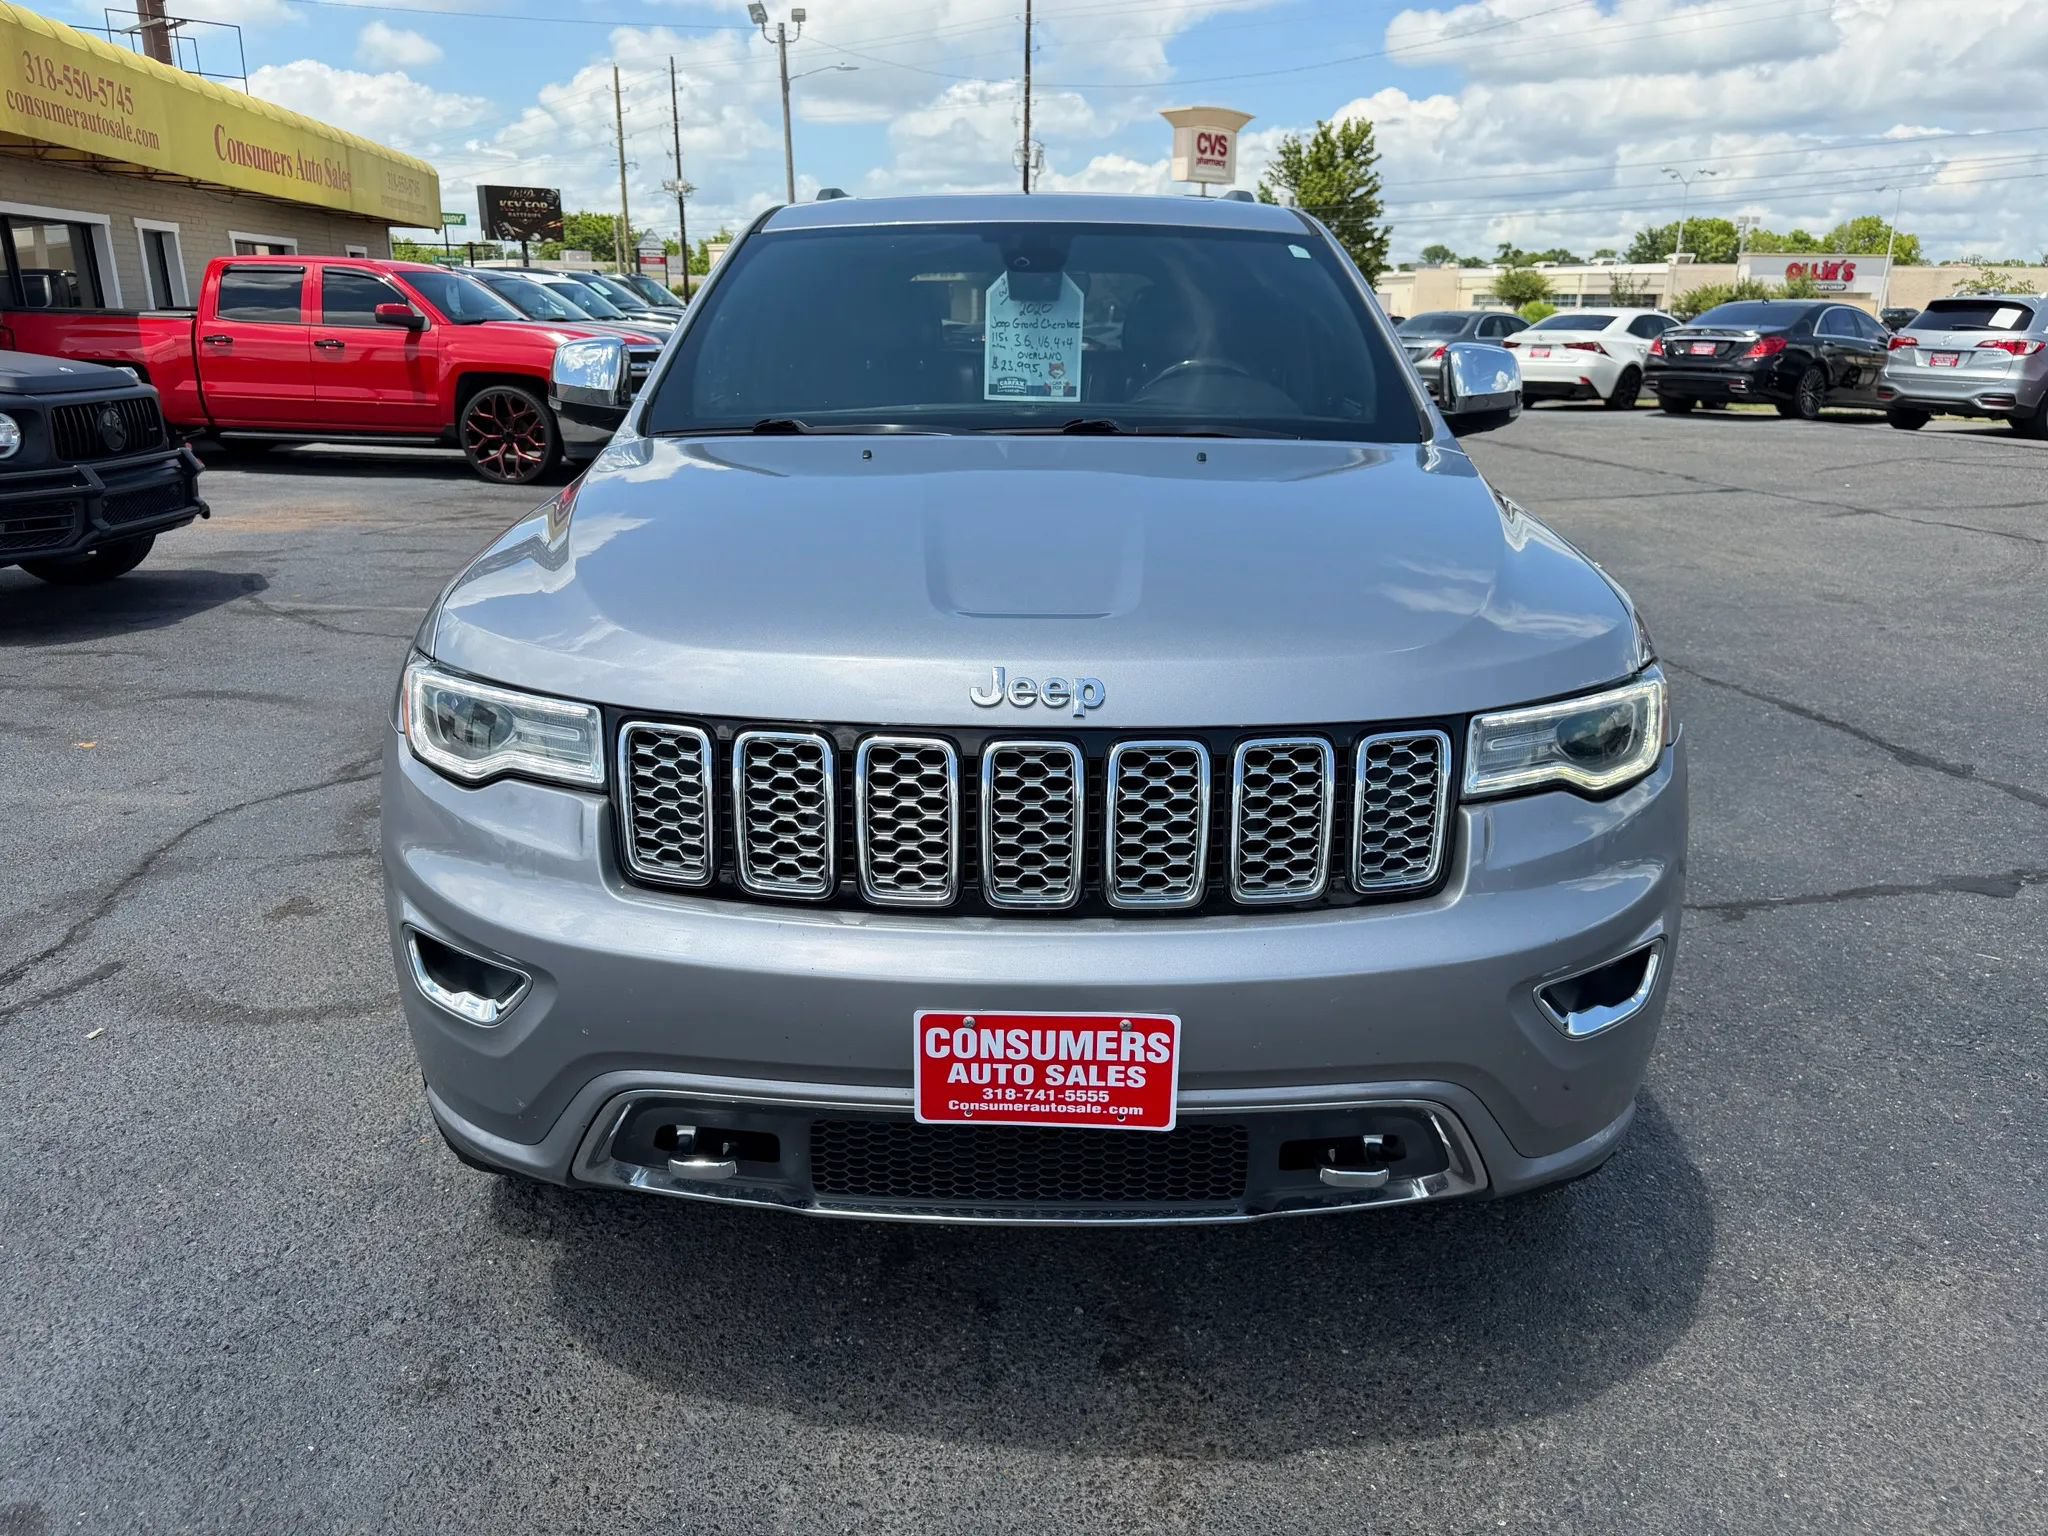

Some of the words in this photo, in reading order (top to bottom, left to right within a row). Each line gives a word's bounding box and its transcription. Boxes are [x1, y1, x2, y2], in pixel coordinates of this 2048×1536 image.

[22, 50, 134, 116] 318-550-5745
[6, 88, 161, 151] consumerautosale.com
[1196, 132, 1228, 157] CVS
[214, 123, 294, 178] Consumers
[296, 147, 323, 186] Auto
[324, 157, 353, 193] Sales
[1196, 157, 1226, 169] pharmacy
[442, 214, 464, 224] WAY
[1019, 303, 1054, 316] 2020
[1012, 318, 1039, 329] Grand
[1041, 318, 1081, 330] Cherokee
[1017, 351, 1063, 361] OVERLAND
[970, 666, 1106, 718] Jeep
[925, 1027, 1171, 1064] CONSUMERS
[947, 1062, 1035, 1085] AUTO
[1045, 1064, 1147, 1088] SALES
[982, 1087, 1110, 1103] 318-741-5555
[948, 1100, 1144, 1116] Consumerautosale.com
